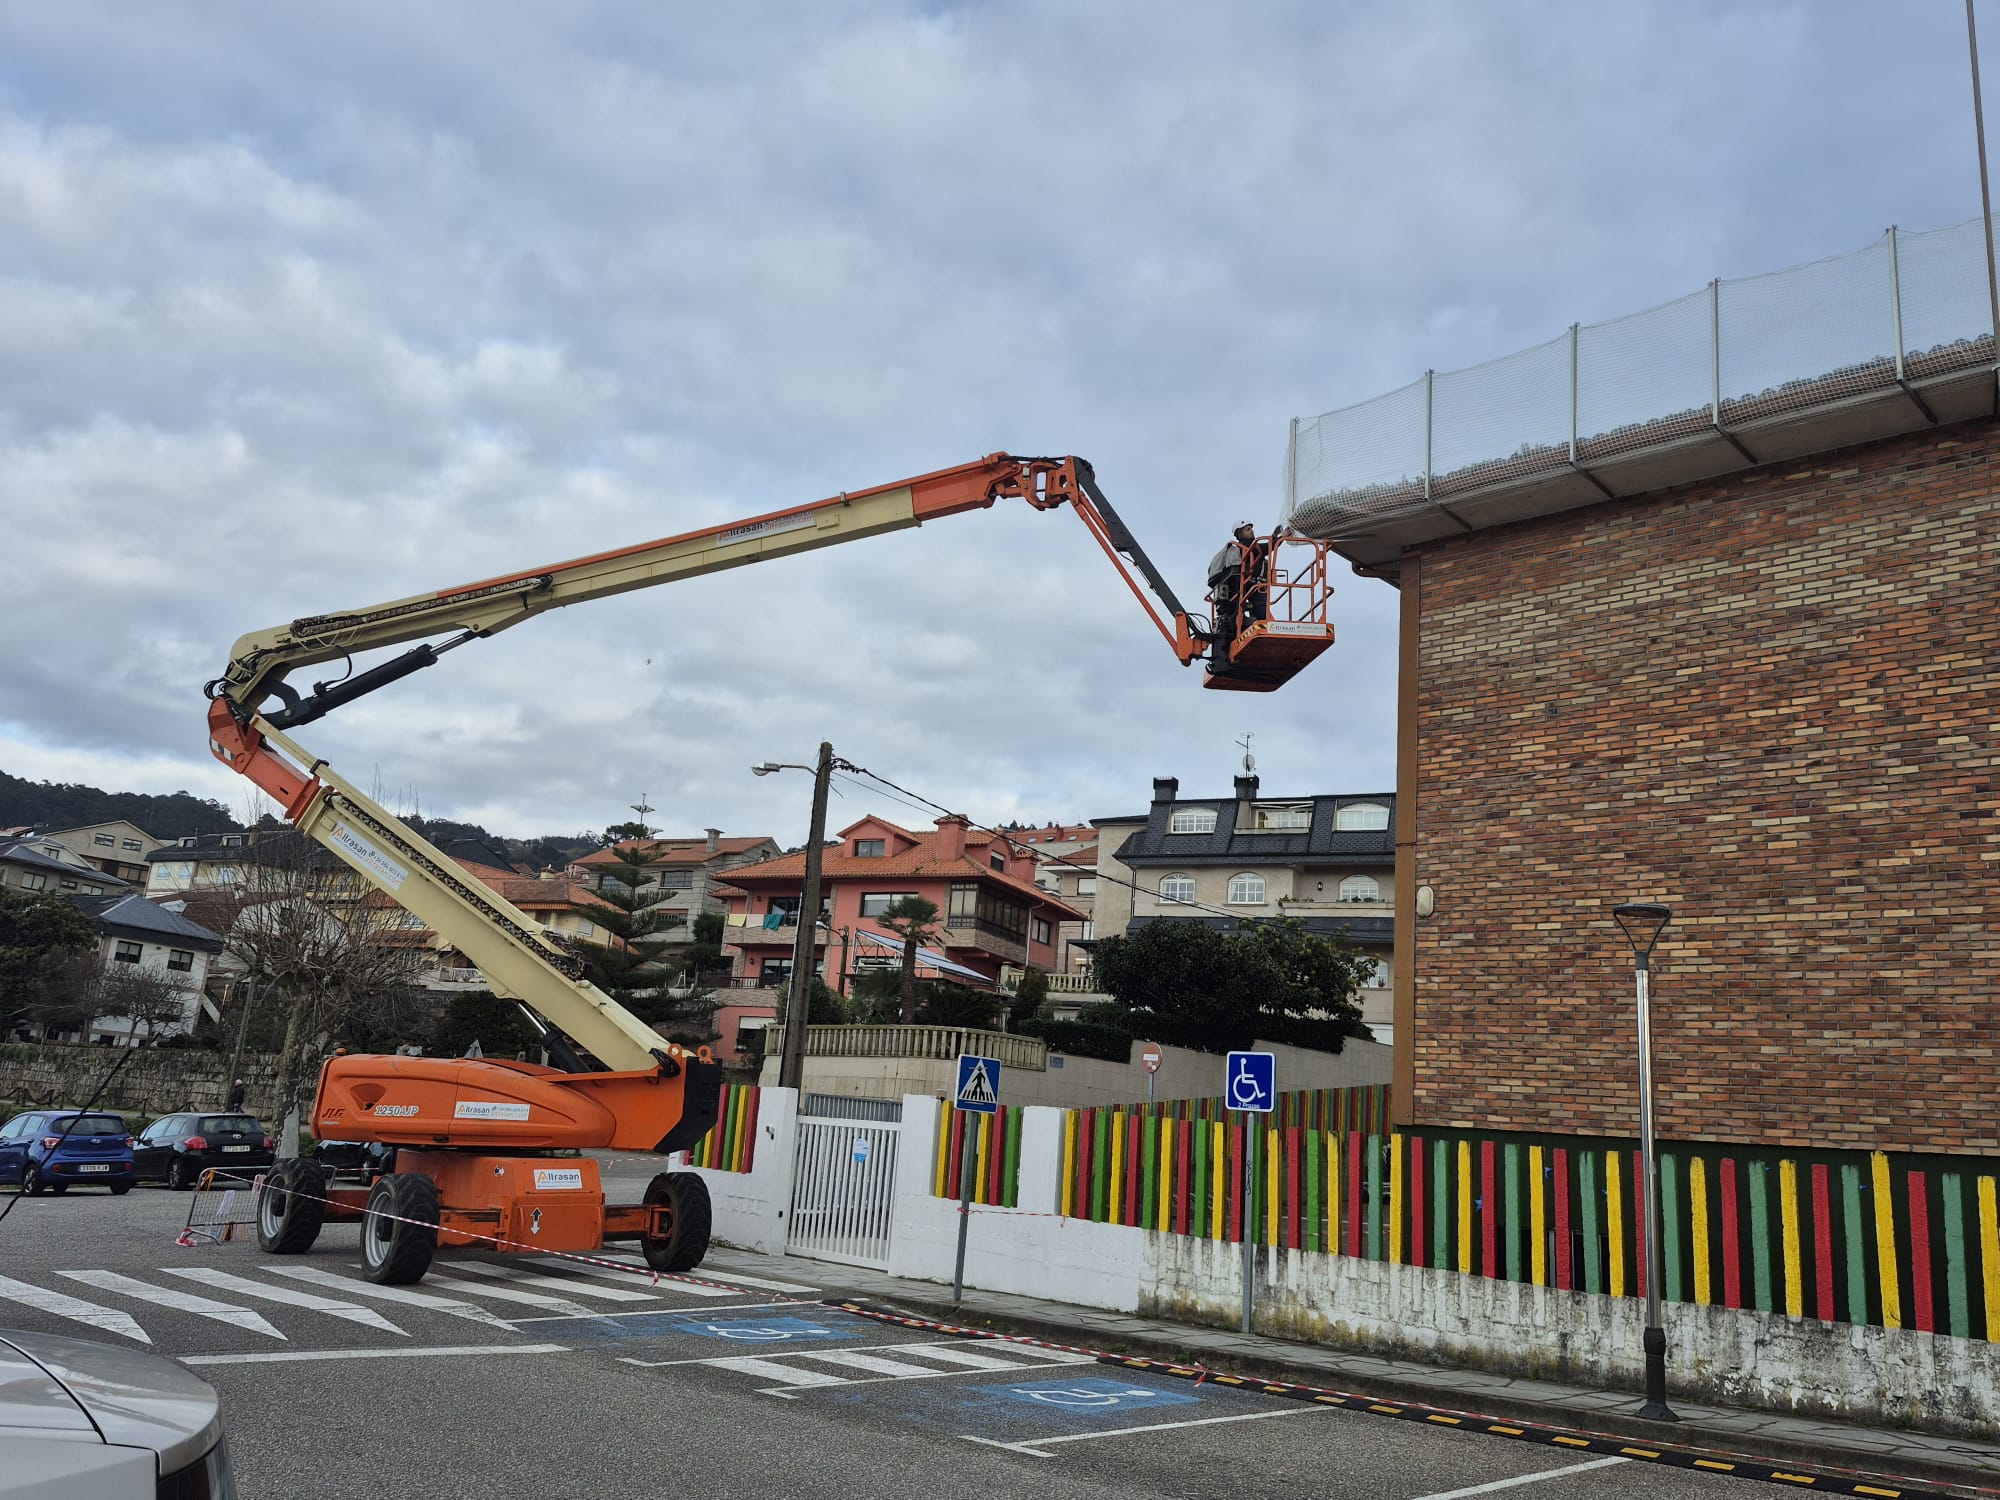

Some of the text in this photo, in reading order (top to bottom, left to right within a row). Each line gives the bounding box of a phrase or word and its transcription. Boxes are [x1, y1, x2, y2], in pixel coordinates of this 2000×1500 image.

[331, 828, 367, 856] Altrasan
[322, 1108, 346, 1119] JLG
[374, 1104, 419, 1118] 1250AJP
[457, 1104, 490, 1114] Altrasan
[538, 1171, 580, 1183] Altrasan
